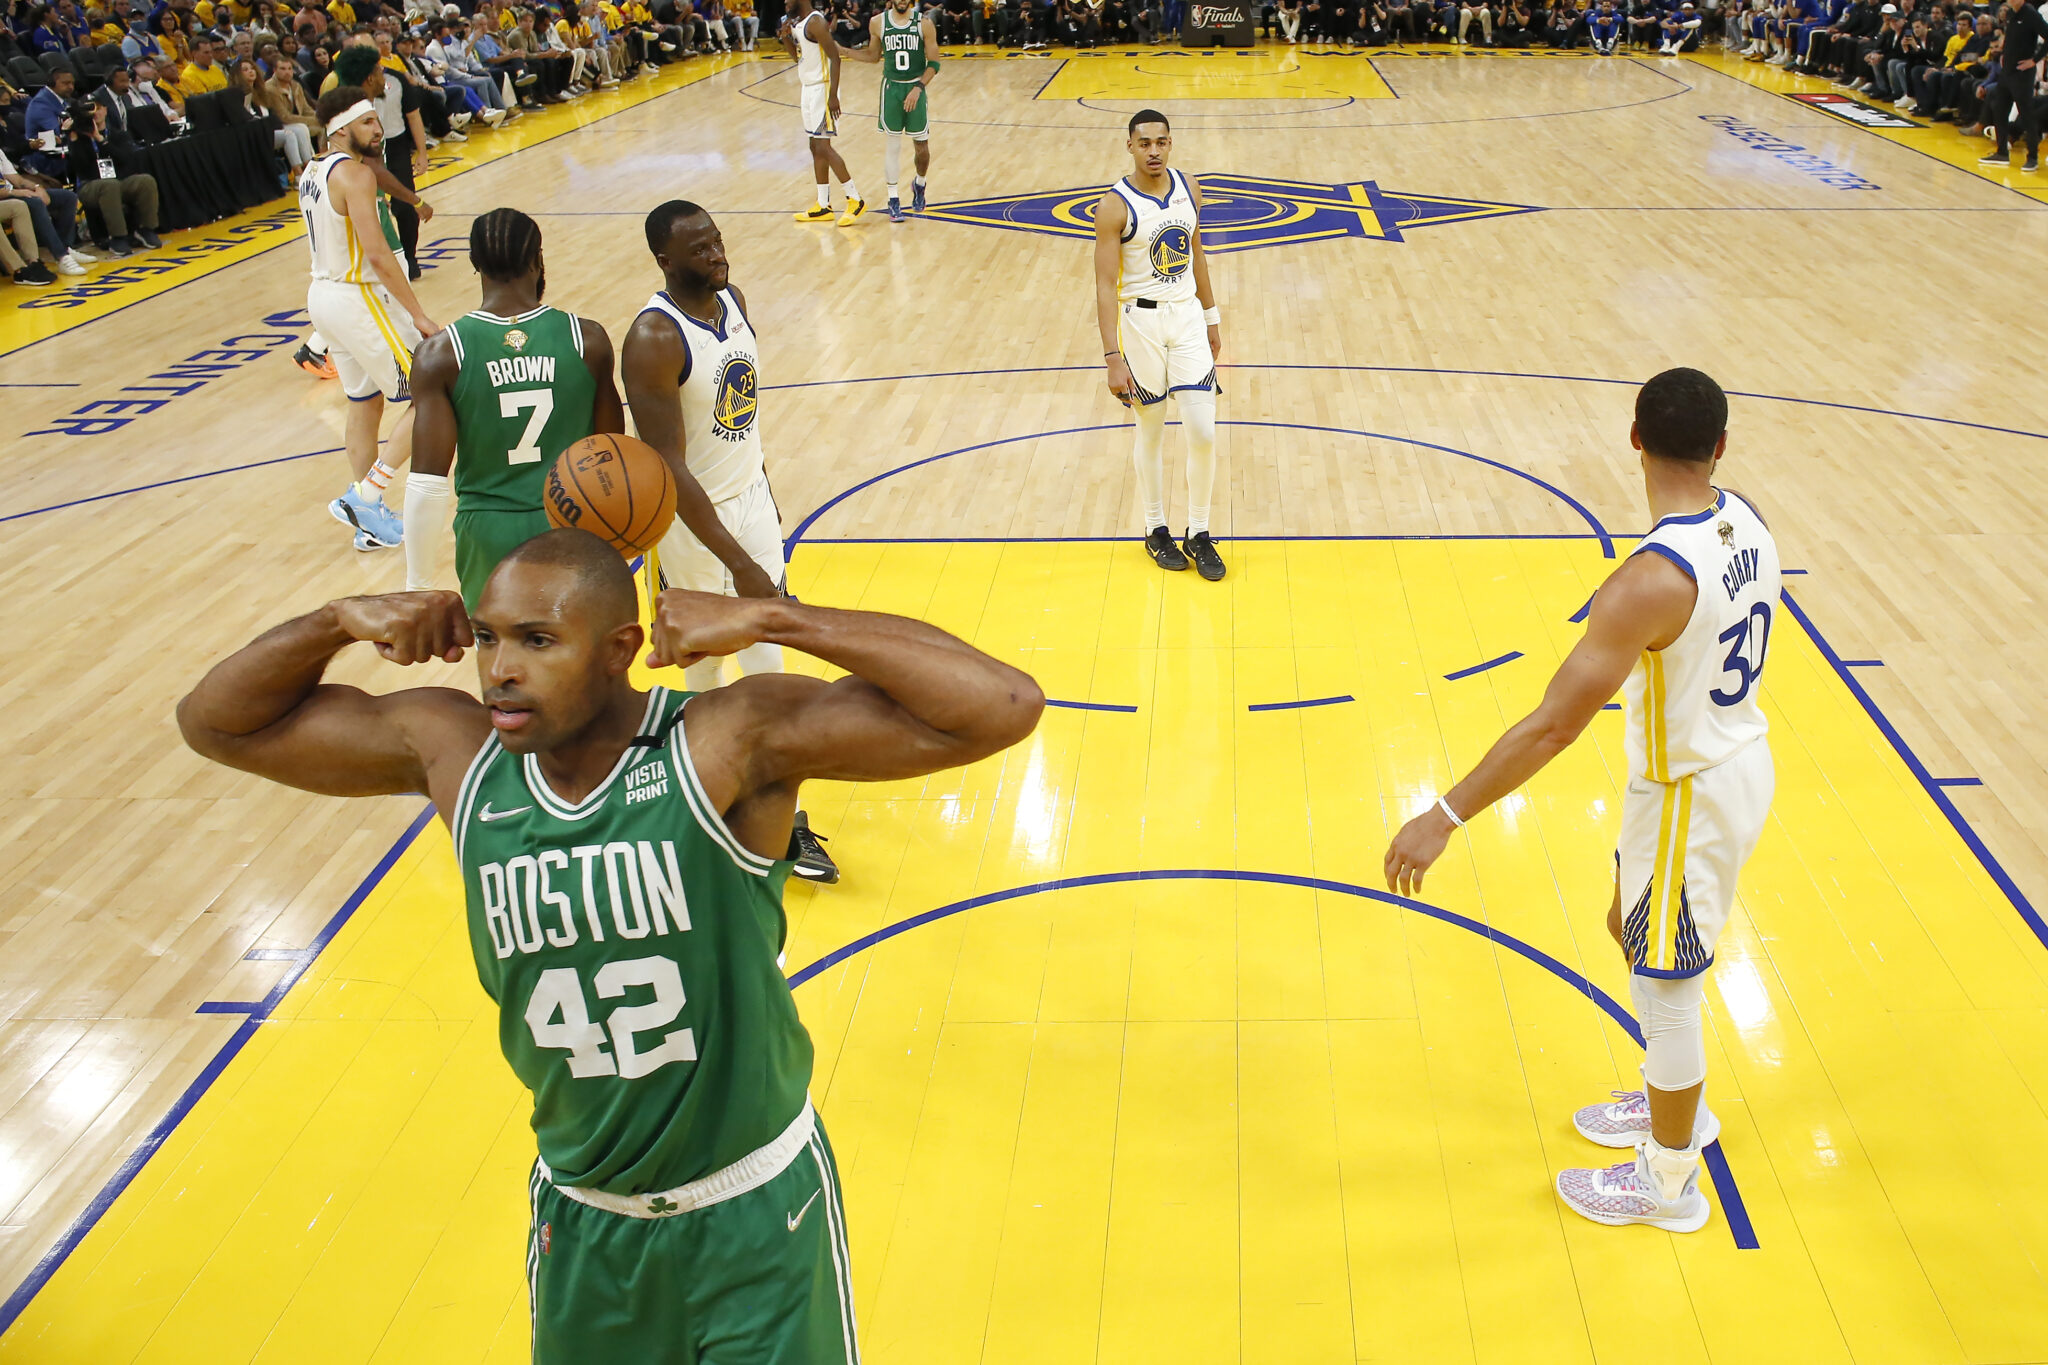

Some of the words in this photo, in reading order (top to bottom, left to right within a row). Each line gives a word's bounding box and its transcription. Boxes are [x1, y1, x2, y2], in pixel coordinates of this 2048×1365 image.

[1197, 6, 1244, 29] Finals
[884, 34, 920, 51] BOSTON
[895, 50, 910, 71] 0
[1697, 115, 1785, 143] CHASE
[1775, 154, 1882, 190] CENTER
[1149, 219, 1172, 242] GOLDEN
[1178, 236, 1186, 250] 3
[18, 254, 211, 309] YEARS
[486, 355, 556, 388] BROWN
[713, 352, 732, 385] GOLDEN
[740, 370, 754, 395] 23
[22, 333, 299, 438] CENTER
[498, 387, 555, 466] 7
[1722, 547, 1759, 602] CURRY
[1709, 601, 1771, 707] 30
[624, 760, 668, 790] VISTA
[625, 779, 669, 806] PRINT
[478, 840, 693, 960] BOSTON
[524, 955, 698, 1080] 42
